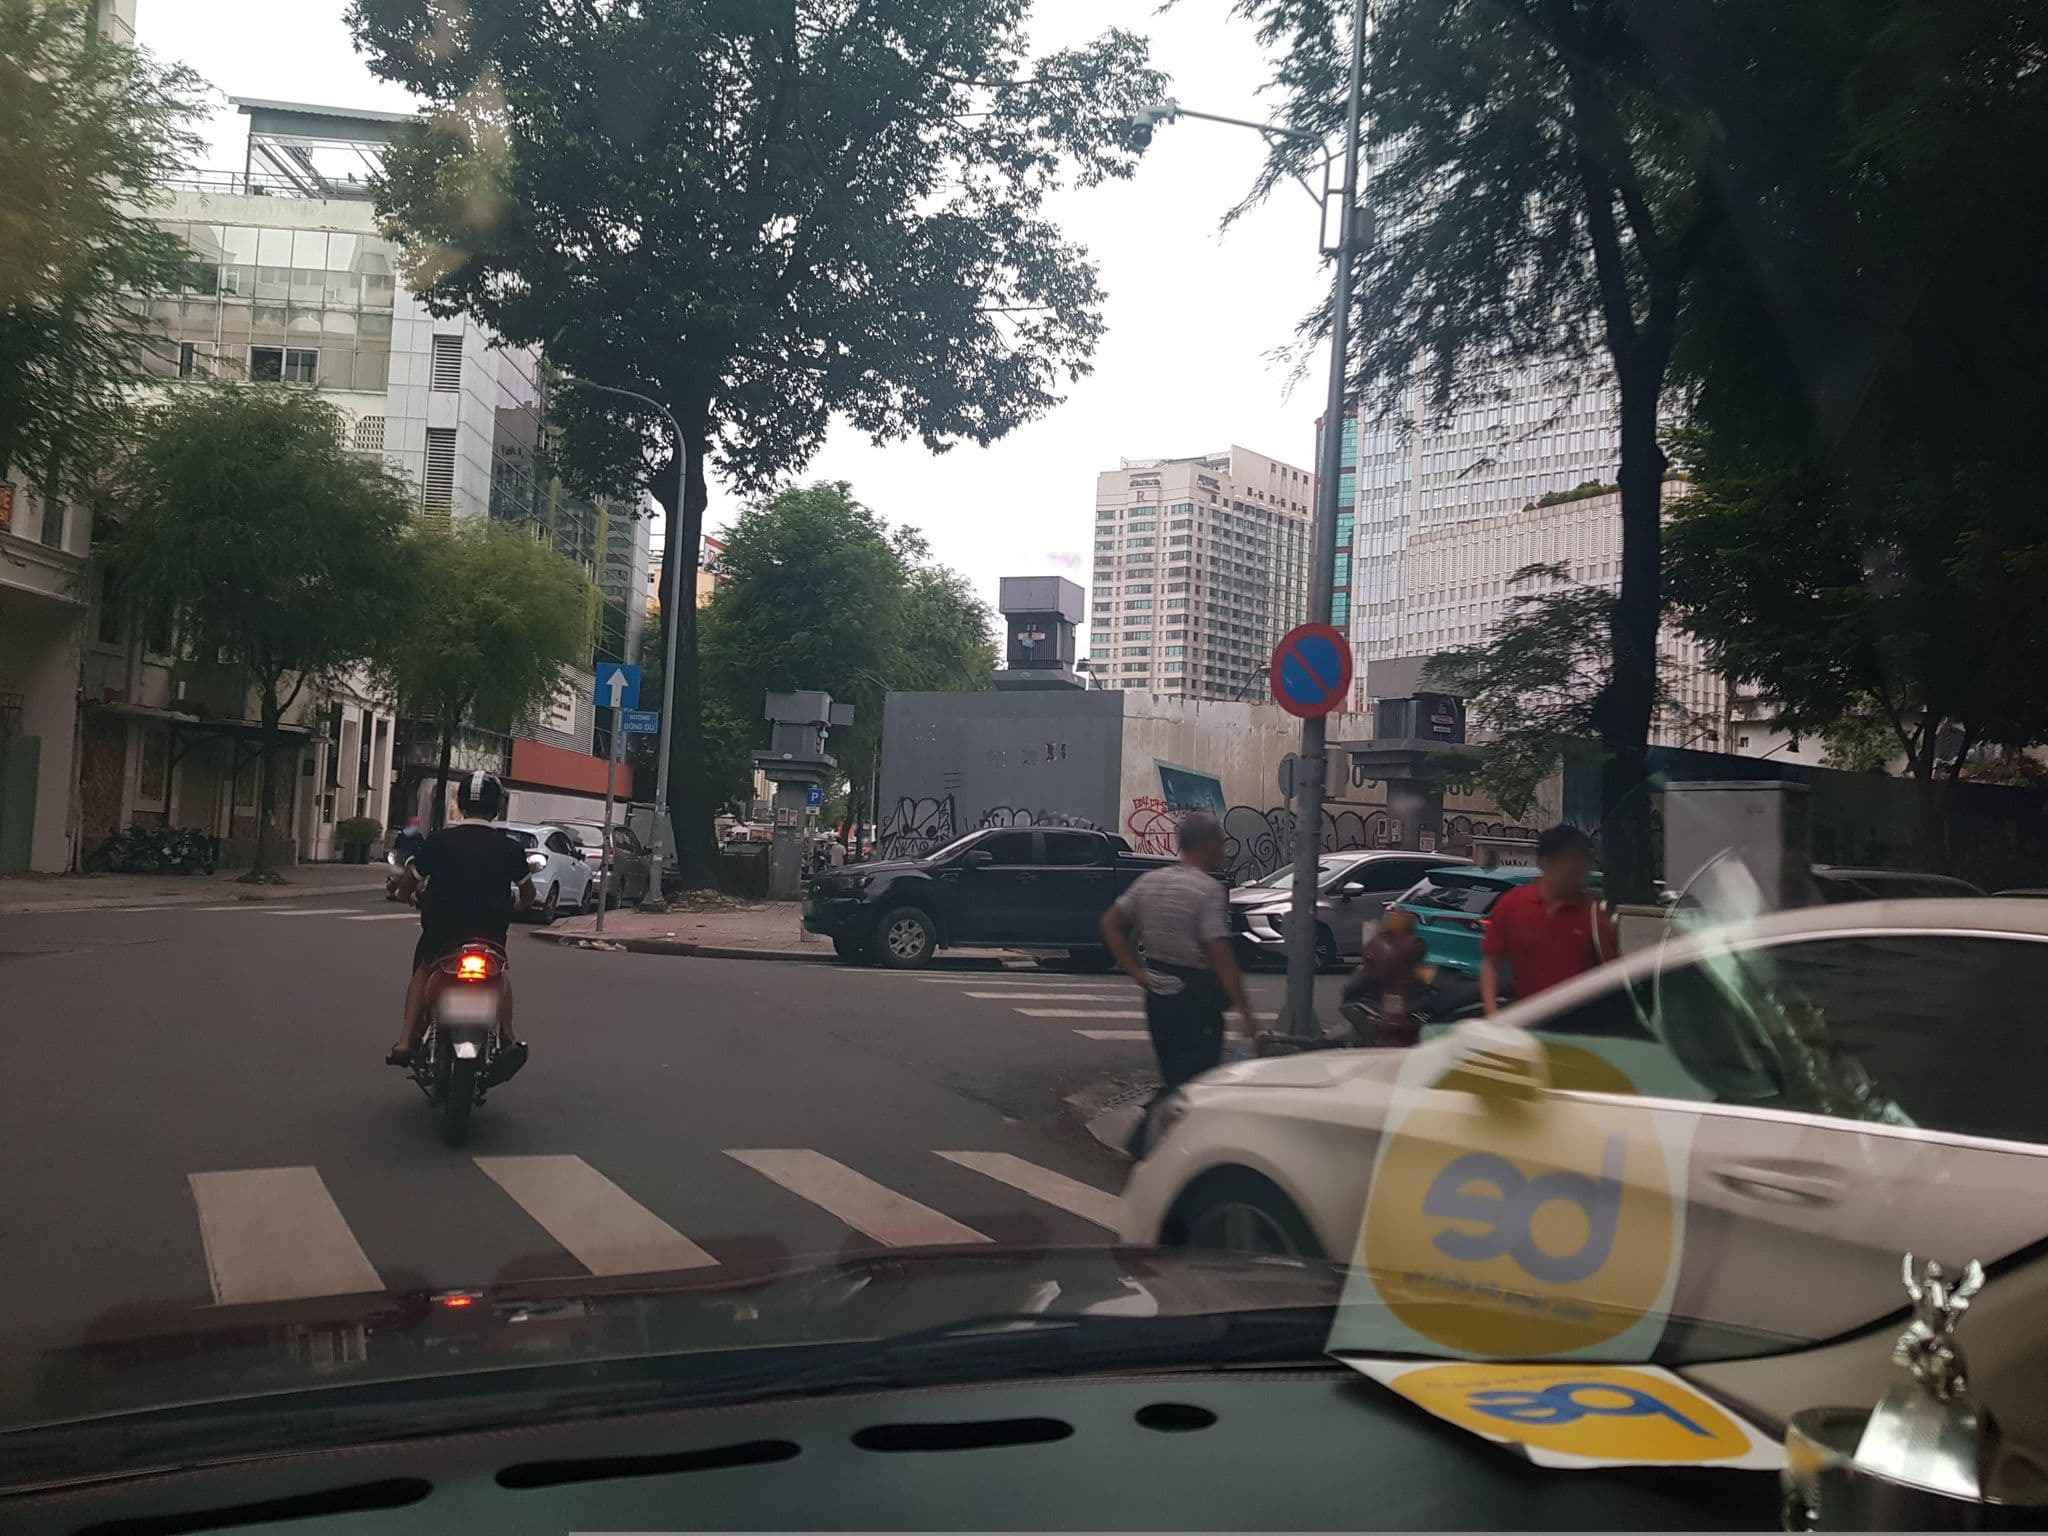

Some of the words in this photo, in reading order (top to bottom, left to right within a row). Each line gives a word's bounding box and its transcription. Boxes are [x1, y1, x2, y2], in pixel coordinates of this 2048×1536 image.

[1136, 490, 1145, 502] R
[811, 792, 819, 802] P
[1465, 1382, 1718, 1439] be
